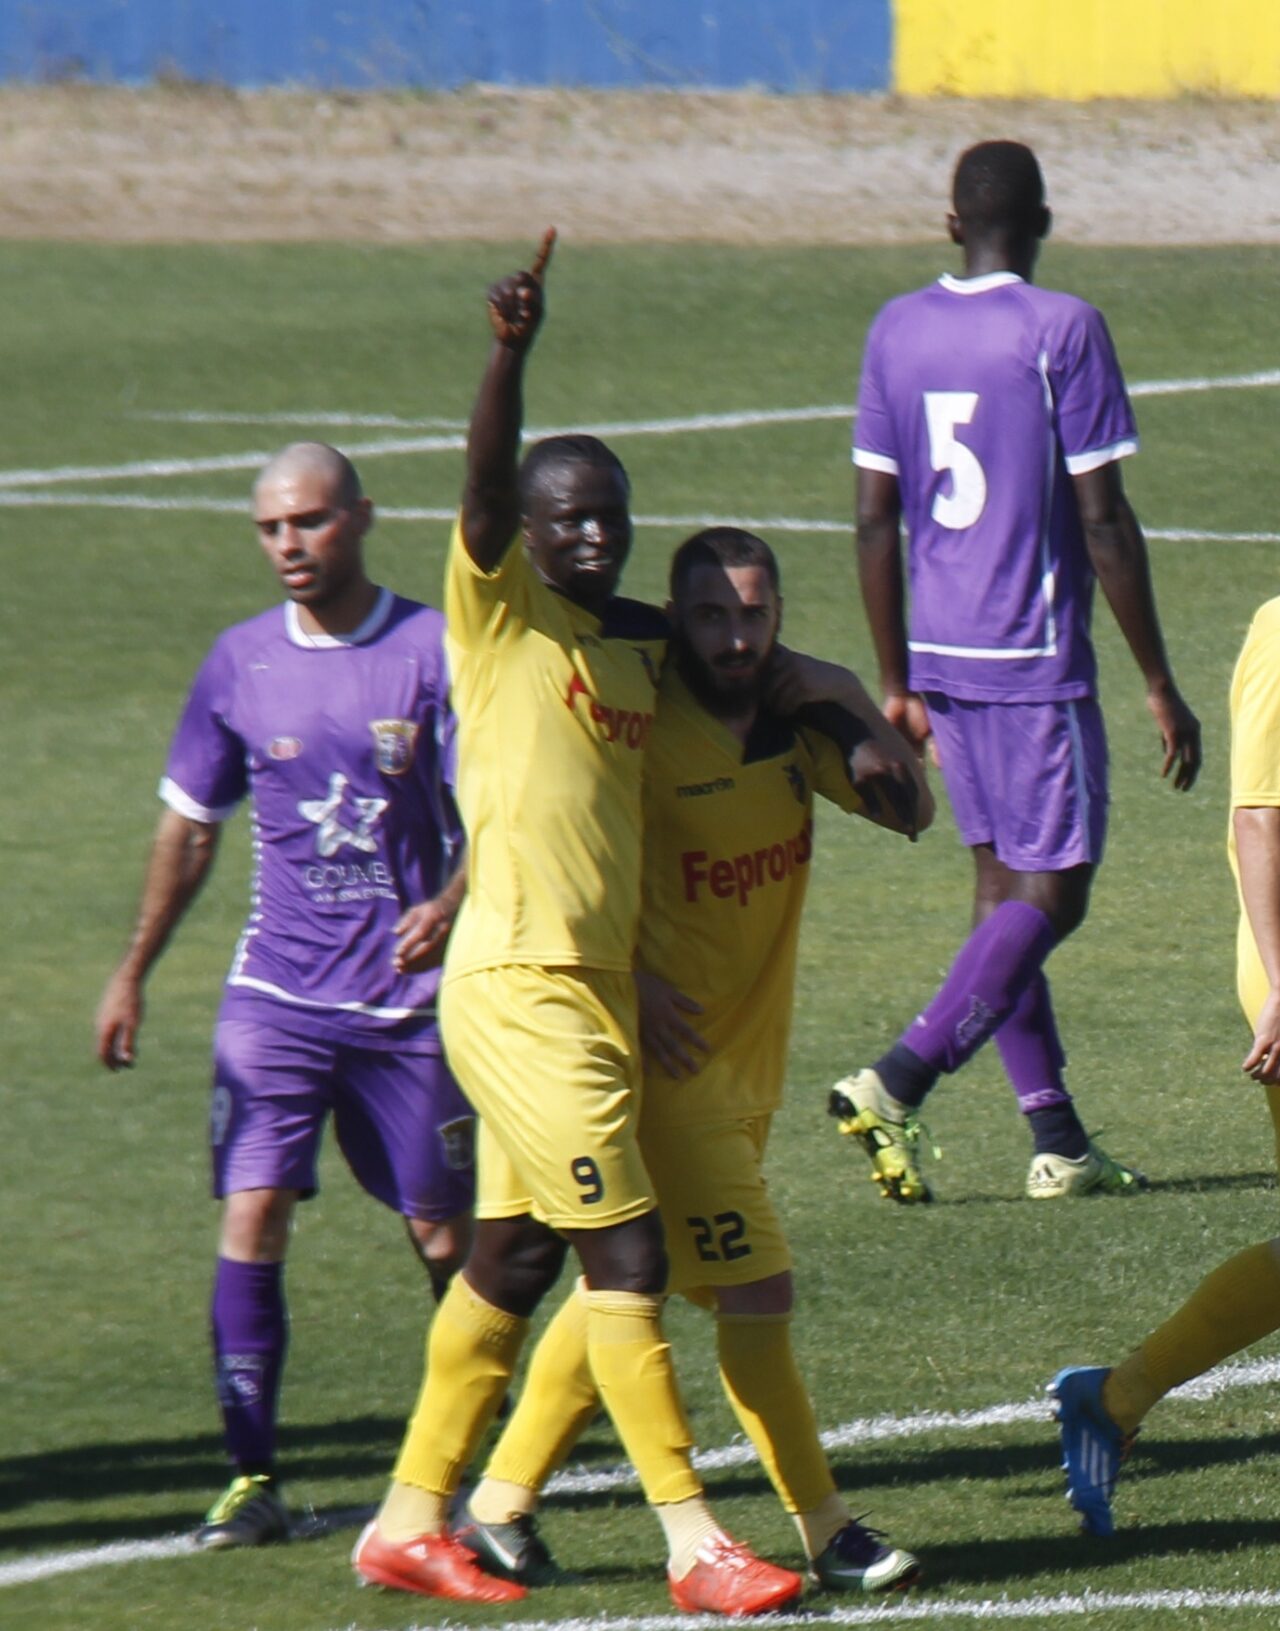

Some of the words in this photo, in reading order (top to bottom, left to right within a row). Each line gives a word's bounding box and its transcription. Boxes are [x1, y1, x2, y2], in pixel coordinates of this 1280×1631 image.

[923, 391, 987, 530] 5
[571, 1156, 604, 1205] 9
[686, 1211, 752, 1262] 22
